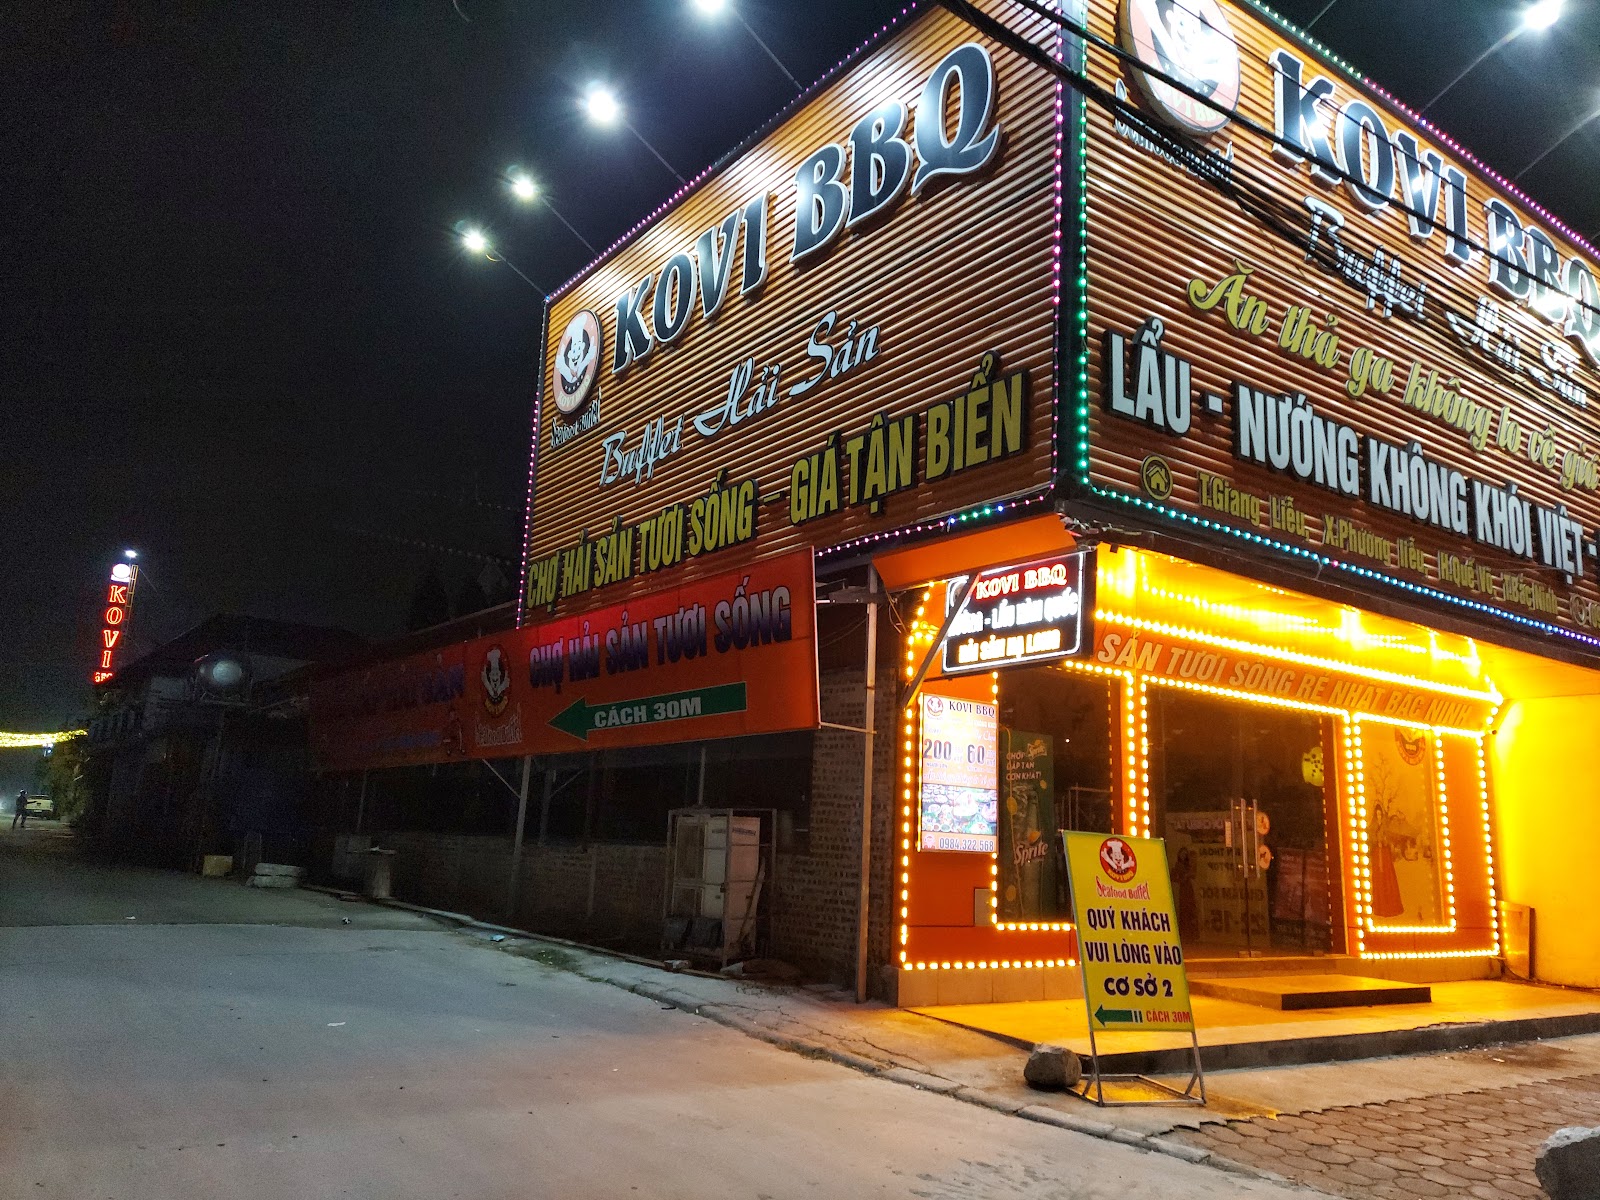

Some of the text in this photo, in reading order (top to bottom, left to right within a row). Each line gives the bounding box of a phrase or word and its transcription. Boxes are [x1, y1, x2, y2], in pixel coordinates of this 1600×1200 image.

[612, 191, 773, 374] KOVI
[789, 43, 1003, 263] BBQ
[1268, 47, 1472, 264] KOVI
[1484, 197, 1600, 368] BBQ
[1187, 259, 1270, 336] Ăn
[1278, 305, 1341, 369] thả
[1346, 347, 1396, 397] ga
[1403, 361, 1492, 451] không
[1497, 405, 1521, 453] lo
[599, 310, 881, 487] Buffet Hải Sản
[1111, 318, 1191, 434] LẨU
[1238, 384, 1360, 496] NƯỚNG
[1368, 438, 1467, 536] KHÔNG
[1474, 479, 1533, 559] KHÓI
[1538, 505, 1584, 585] VIỆT
[527, 551, 560, 612] CHỢ
[561, 530, 592, 598] HẢI
[594, 516, 633, 587] SẢN
[639, 503, 685, 574] TƯƠI
[688, 469, 755, 556] SỐNG
[789, 434, 839, 525] GIÁ
[846, 413, 914, 515] TẬN
[925, 352, 1024, 480] BIỂN
[1199, 472, 1261, 528] T.Giang
[975, 563, 1067, 600] KOVI BBQ
[102, 584, 128, 668] KOVI
[529, 637, 563, 694] CHỢ
[568, 620, 599, 682] HẢI
[605, 610, 649, 675] SẢN
[653, 602, 707, 666] TƯƠI
[714, 576, 793, 654] SỐNG
[1097, 631, 1163, 672] SẢN
[1166, 646, 1228, 683] TƯƠI
[1424, 698, 1473, 727] NINH
[594, 697, 702, 728] CÁCH 30M
[949, 700, 995, 718] KOVI BBQ
[923, 738, 952, 761] 200
[967, 744, 985, 764] 60
[939, 838, 994, 852] 0984.322.568
[1014, 842, 1048, 865] Sprite
[1096, 875, 1150, 900] Seafood Buffet
[1087, 905, 1170, 932] QUÝ KHÁCH
[1085, 938, 1182, 966] VUI LÒNG VÀO
[1104, 972, 1173, 998] CƠ SỞ 2
[1146, 1007, 1191, 1024] CÁCH 30M
